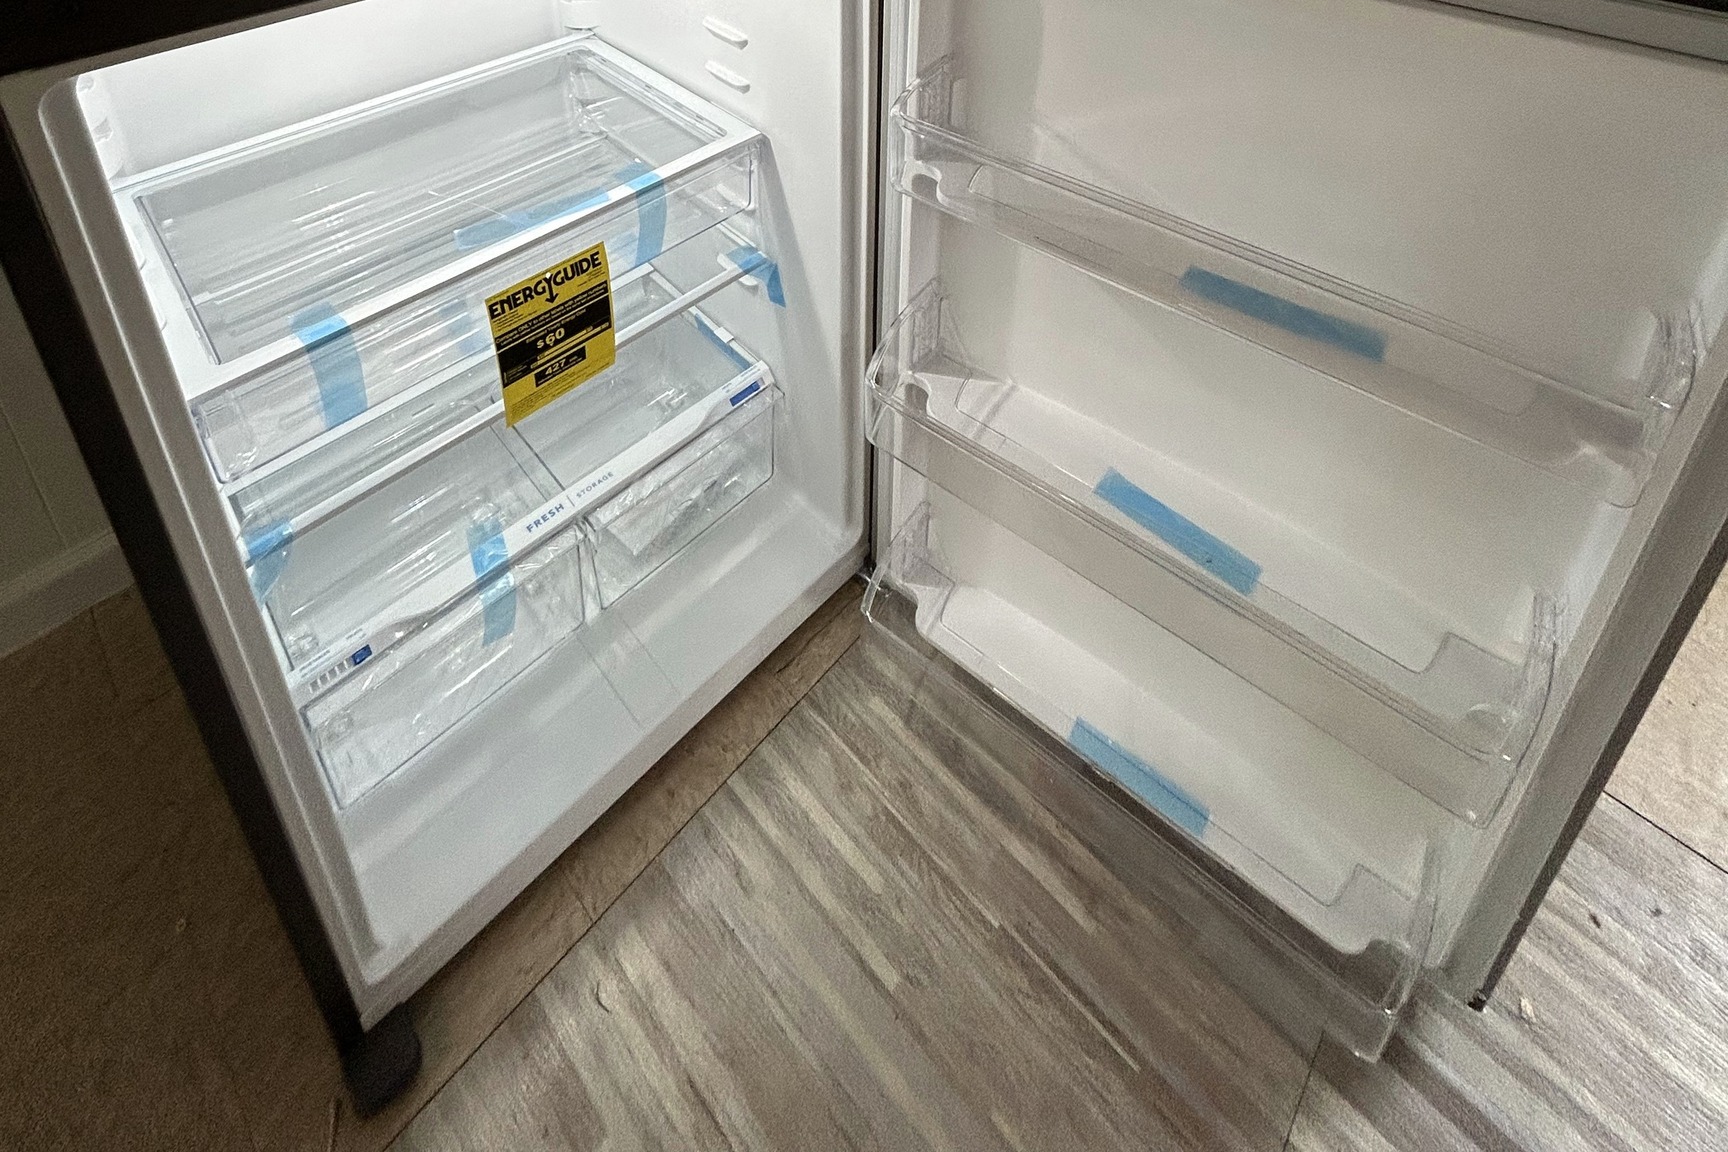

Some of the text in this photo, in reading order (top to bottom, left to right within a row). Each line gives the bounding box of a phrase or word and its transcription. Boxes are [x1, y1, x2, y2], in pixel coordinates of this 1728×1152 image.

[488, 250, 602, 320] ENERGYGUIDE
[536, 328, 565, 349] $60
[545, 358, 567, 376] 427
[526, 471, 614, 533] FRESH STORAGE
